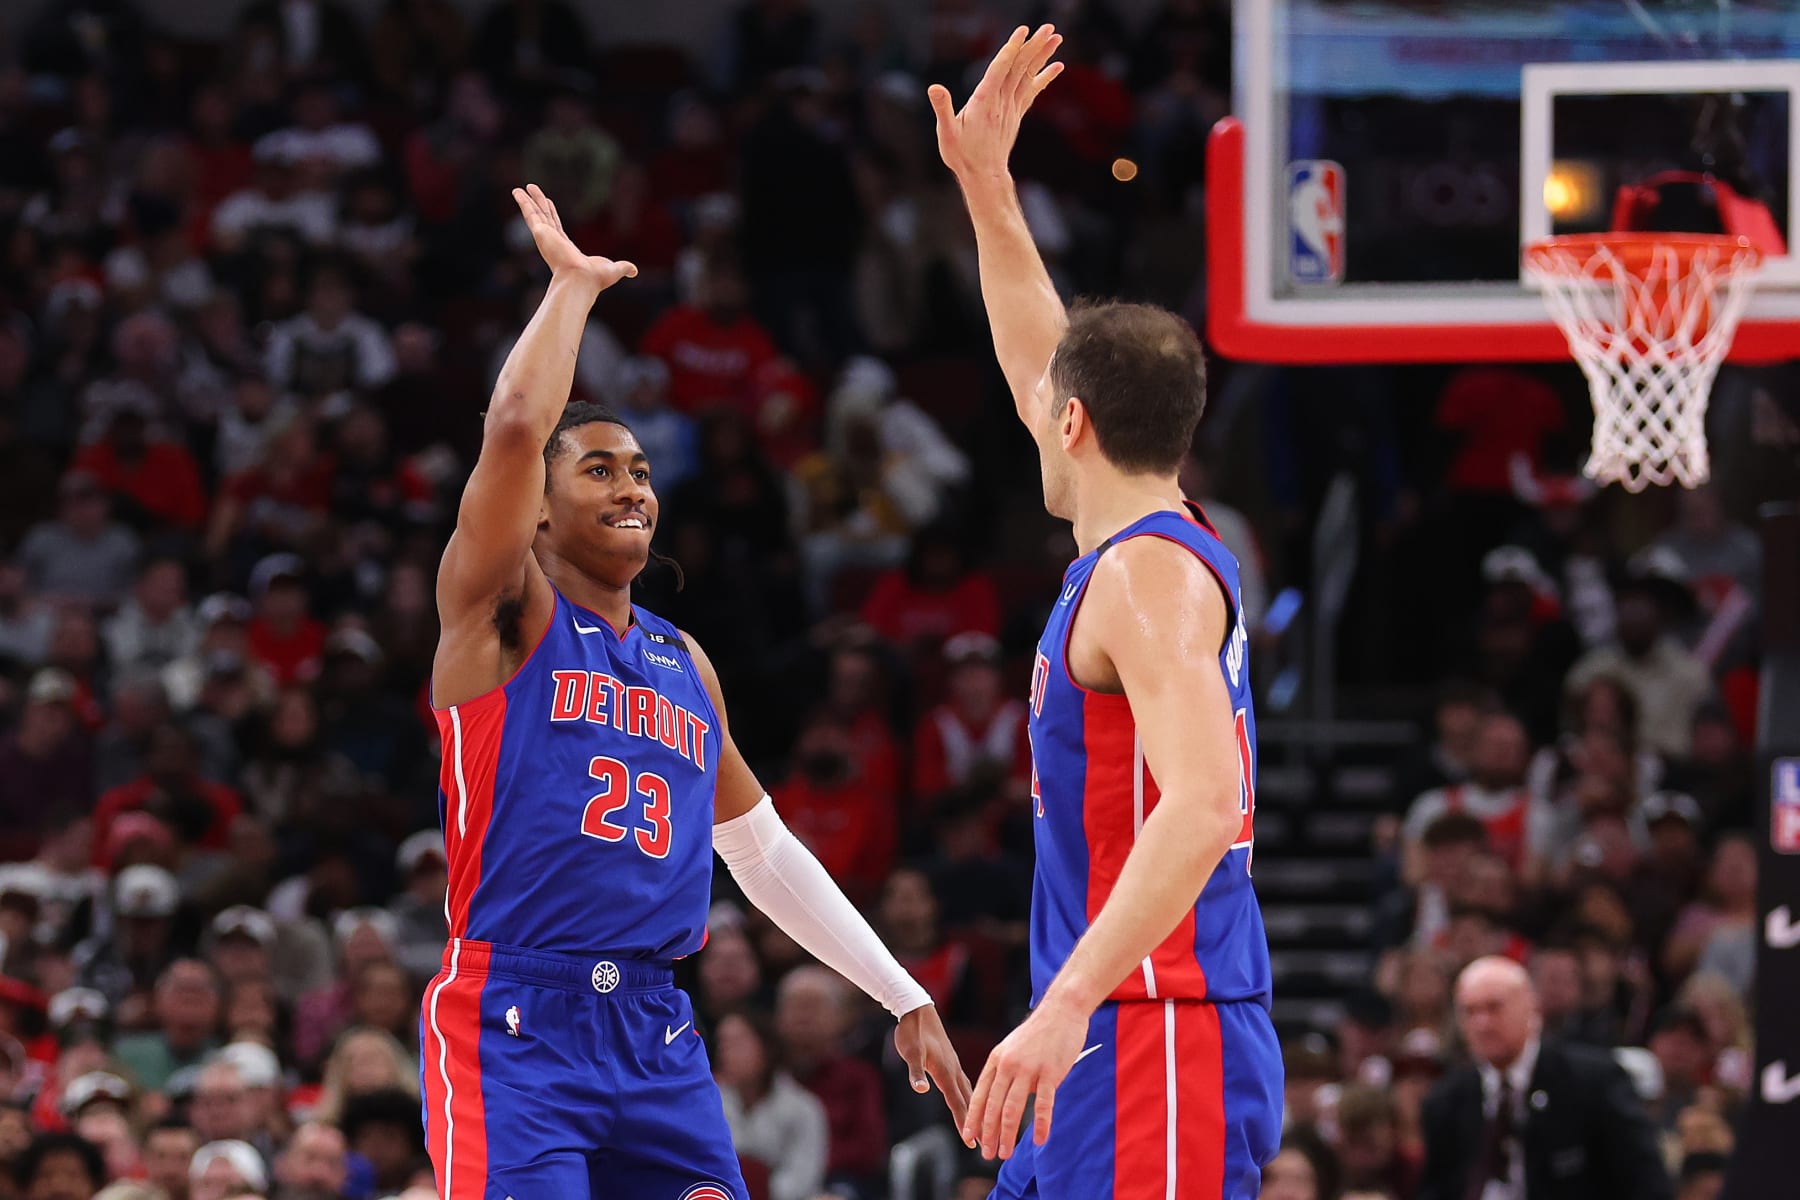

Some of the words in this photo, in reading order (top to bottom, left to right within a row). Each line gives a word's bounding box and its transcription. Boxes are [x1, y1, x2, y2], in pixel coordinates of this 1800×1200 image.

[642, 648, 681, 669] UWM
[649, 633, 665, 644] 16
[550, 670, 709, 772] DETROIT
[581, 756, 672, 859] 23
